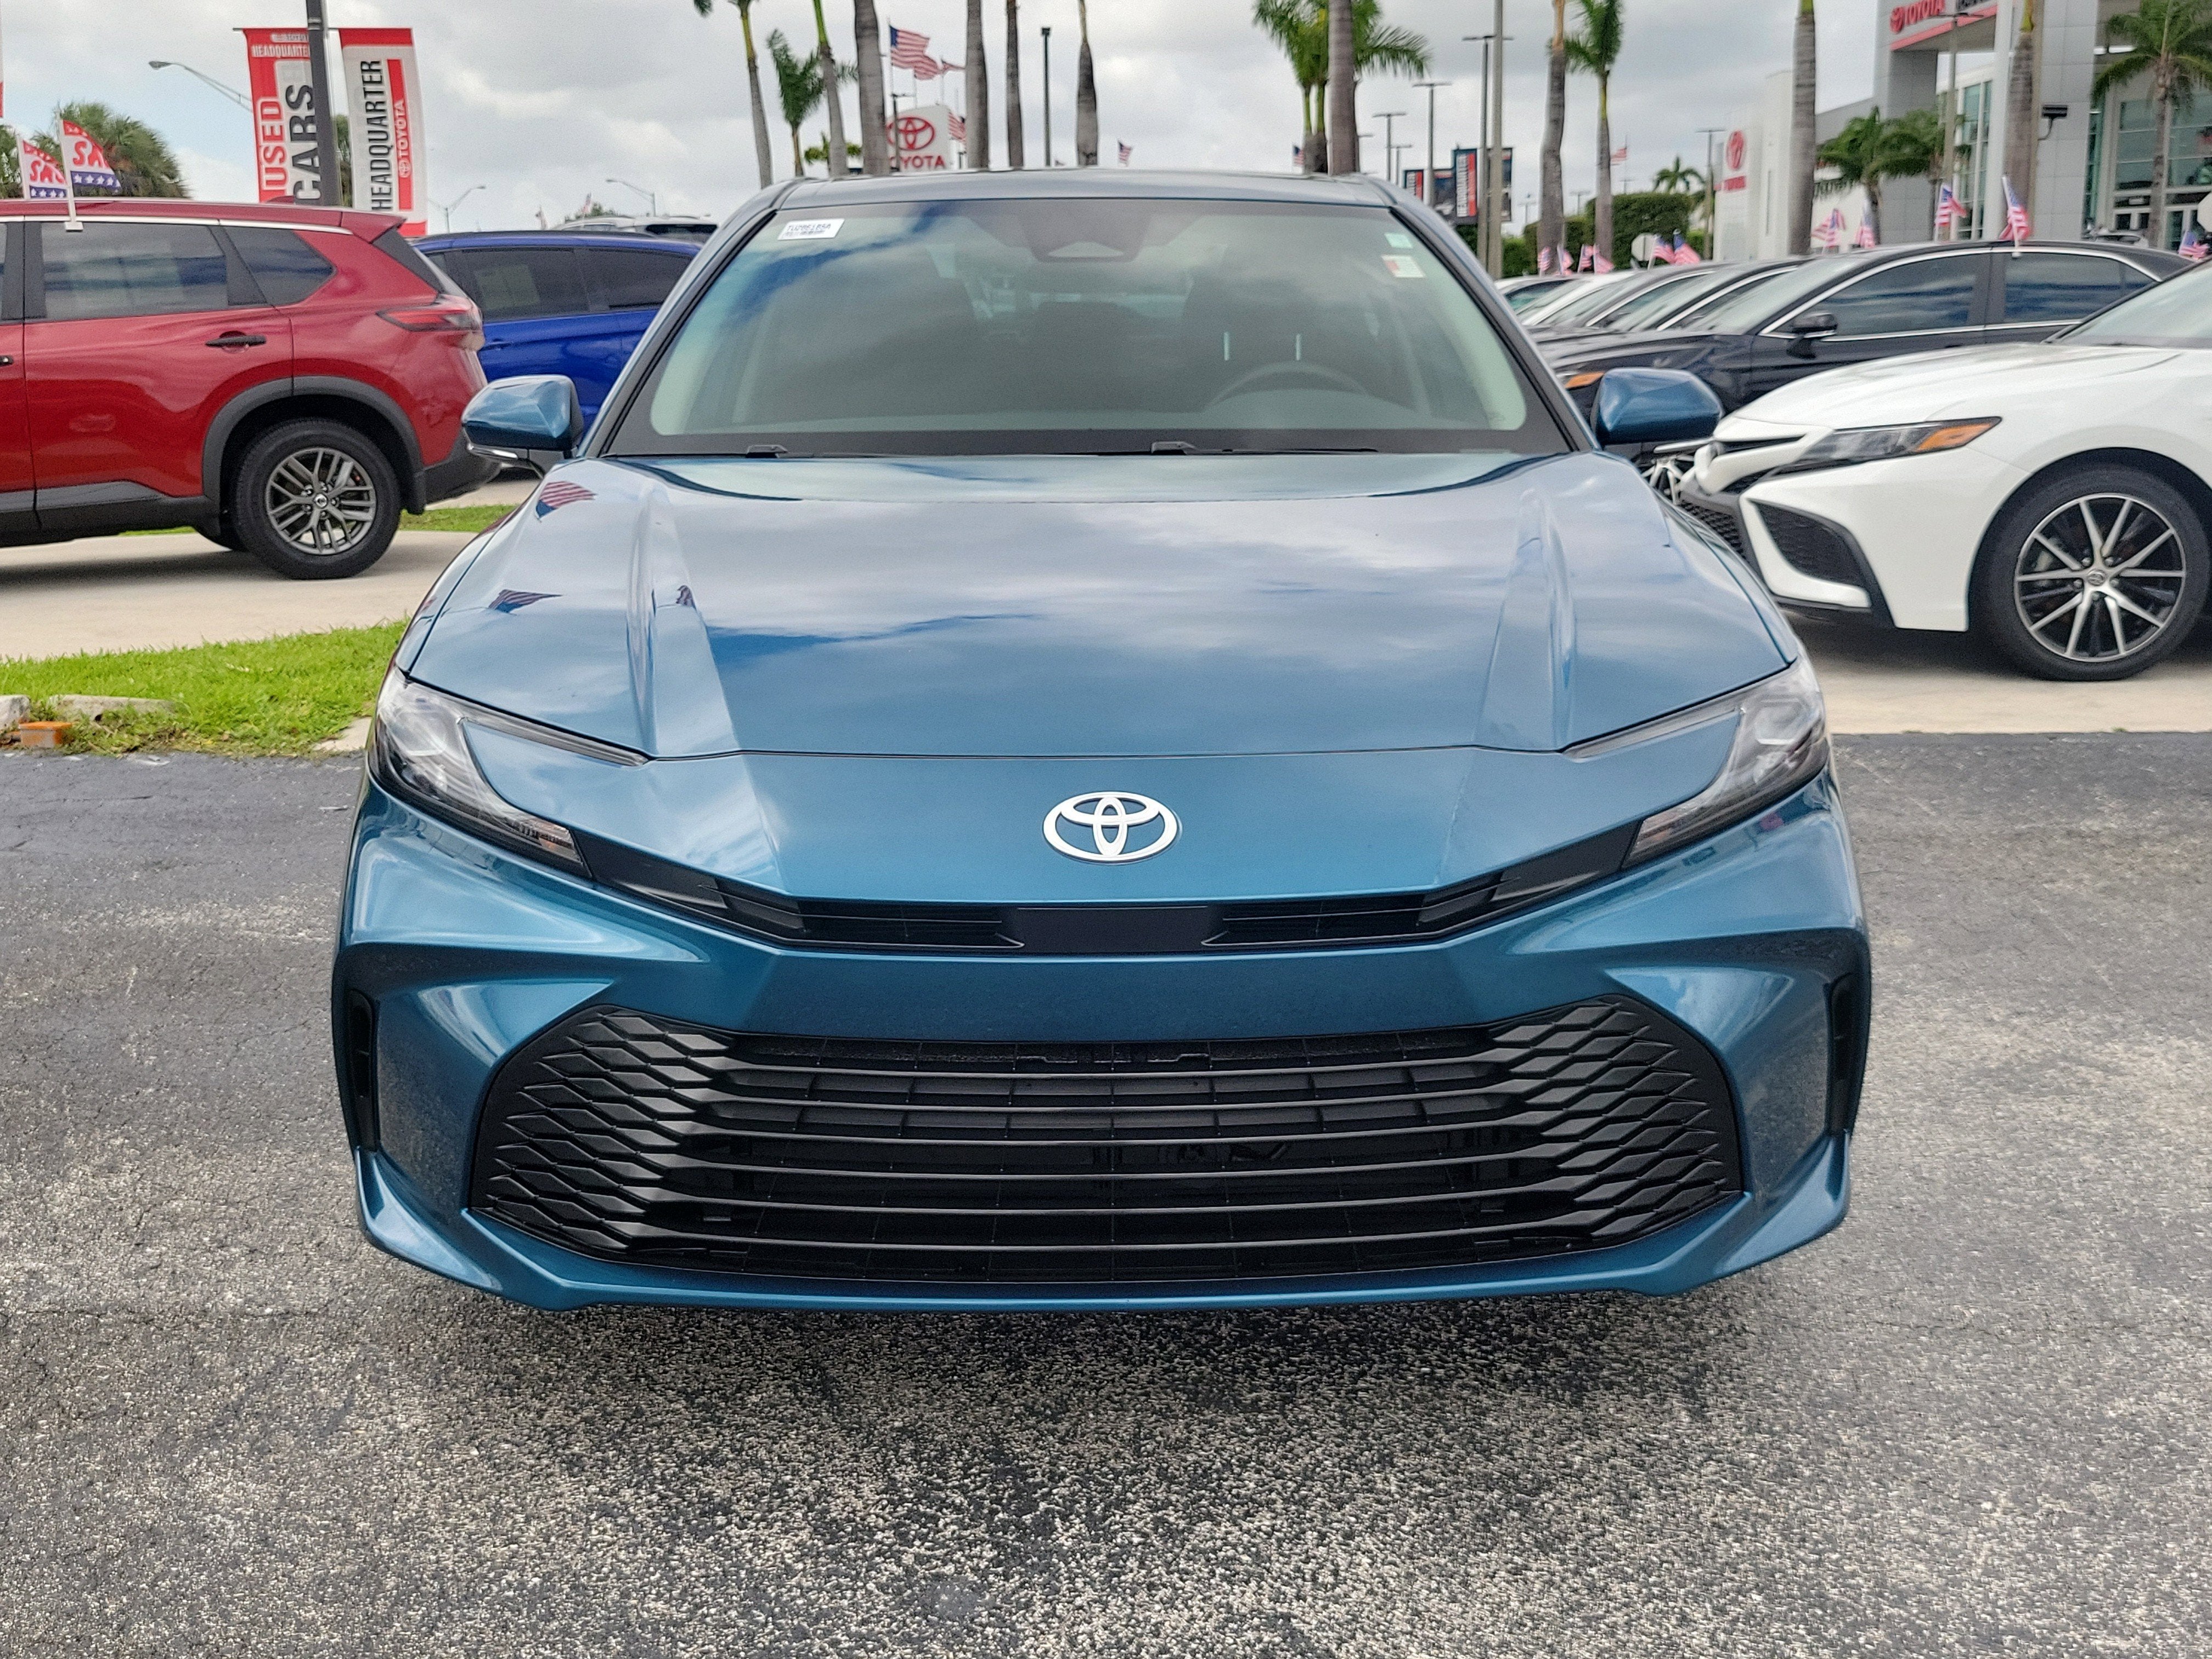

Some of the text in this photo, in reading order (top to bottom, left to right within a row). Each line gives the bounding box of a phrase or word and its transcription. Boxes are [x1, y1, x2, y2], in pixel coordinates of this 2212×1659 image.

[251, 44, 310, 58] HEADQUARTE
[261, 101, 288, 187] USED
[285, 85, 321, 204] CARS
[360, 60, 394, 211] HEADQUARTER
[394, 99, 409, 157] TOYOTA
